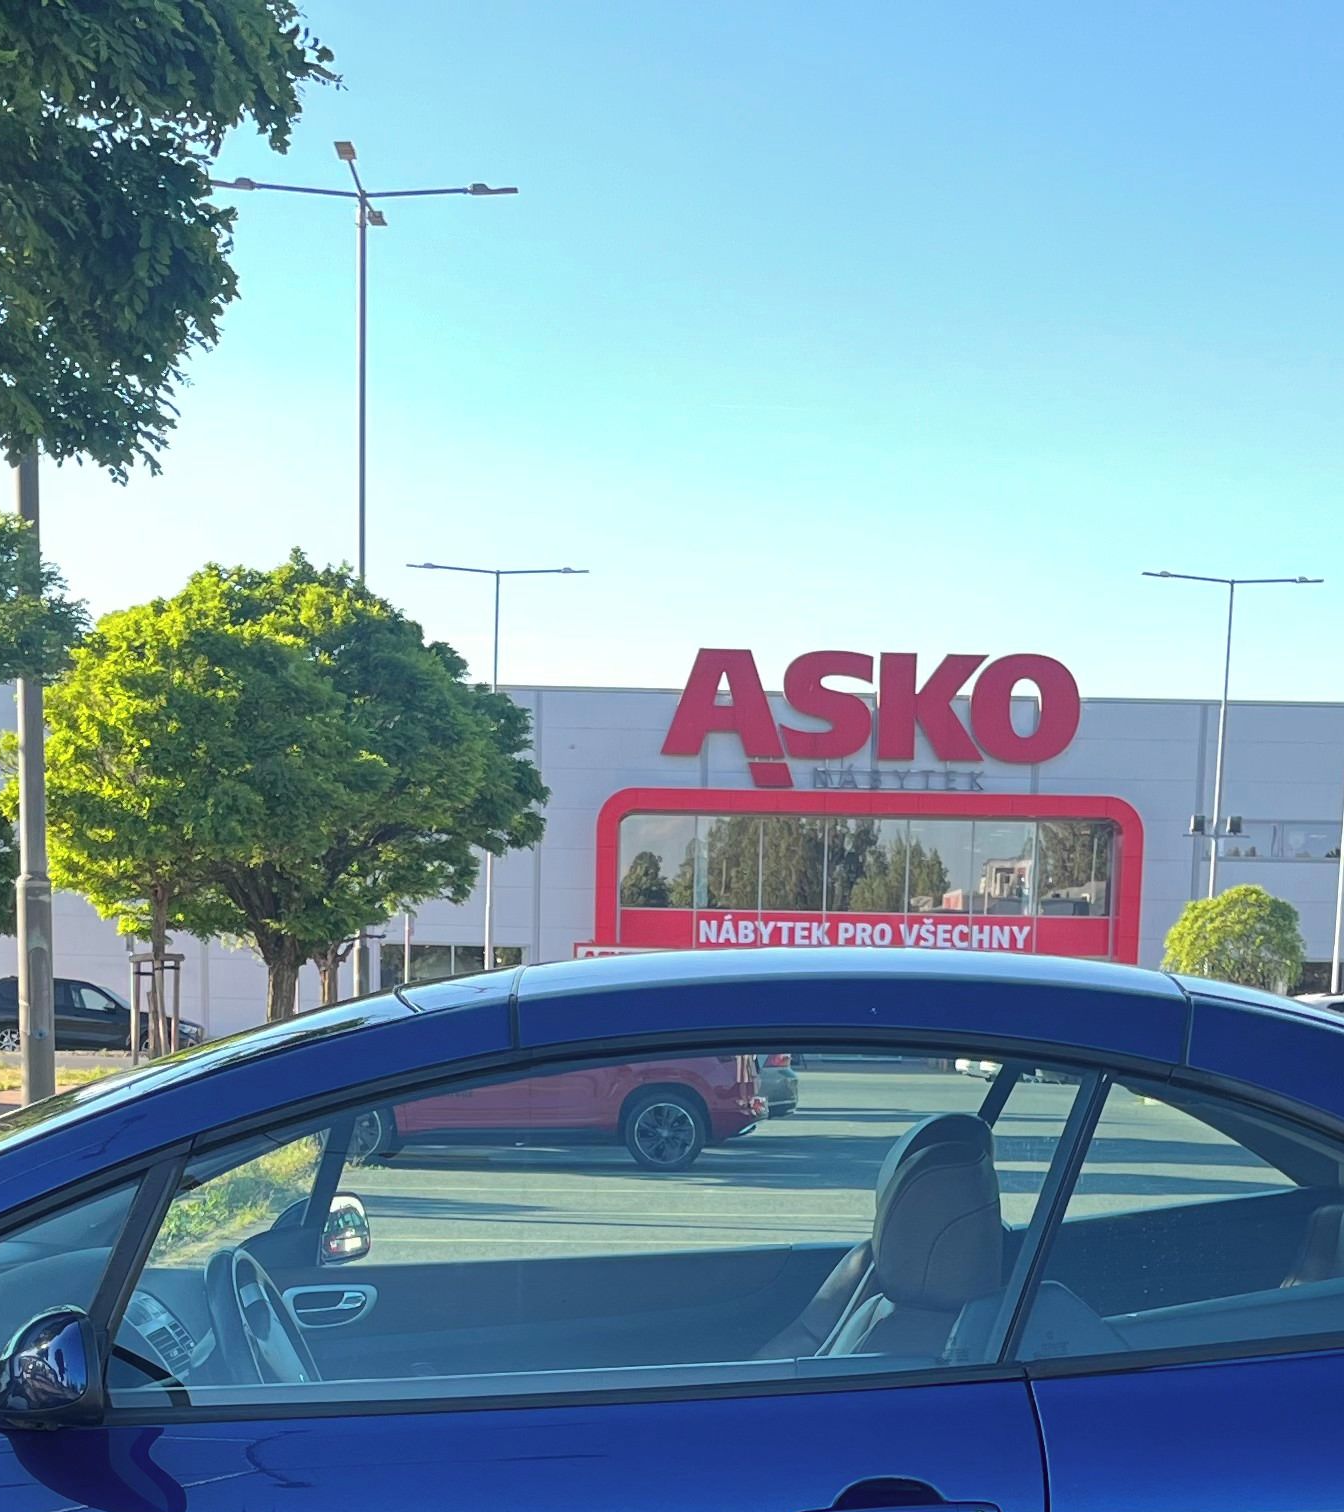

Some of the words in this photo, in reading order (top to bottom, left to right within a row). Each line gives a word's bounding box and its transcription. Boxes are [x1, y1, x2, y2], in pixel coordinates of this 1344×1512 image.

[660, 647, 1081, 788] ASKO
[813, 763, 985, 791] NÁBYTEK
[698, 914, 831, 945] NÁBYTEK
[837, 922, 892, 946] PRO
[899, 918, 1031, 949] VŠECHNY
